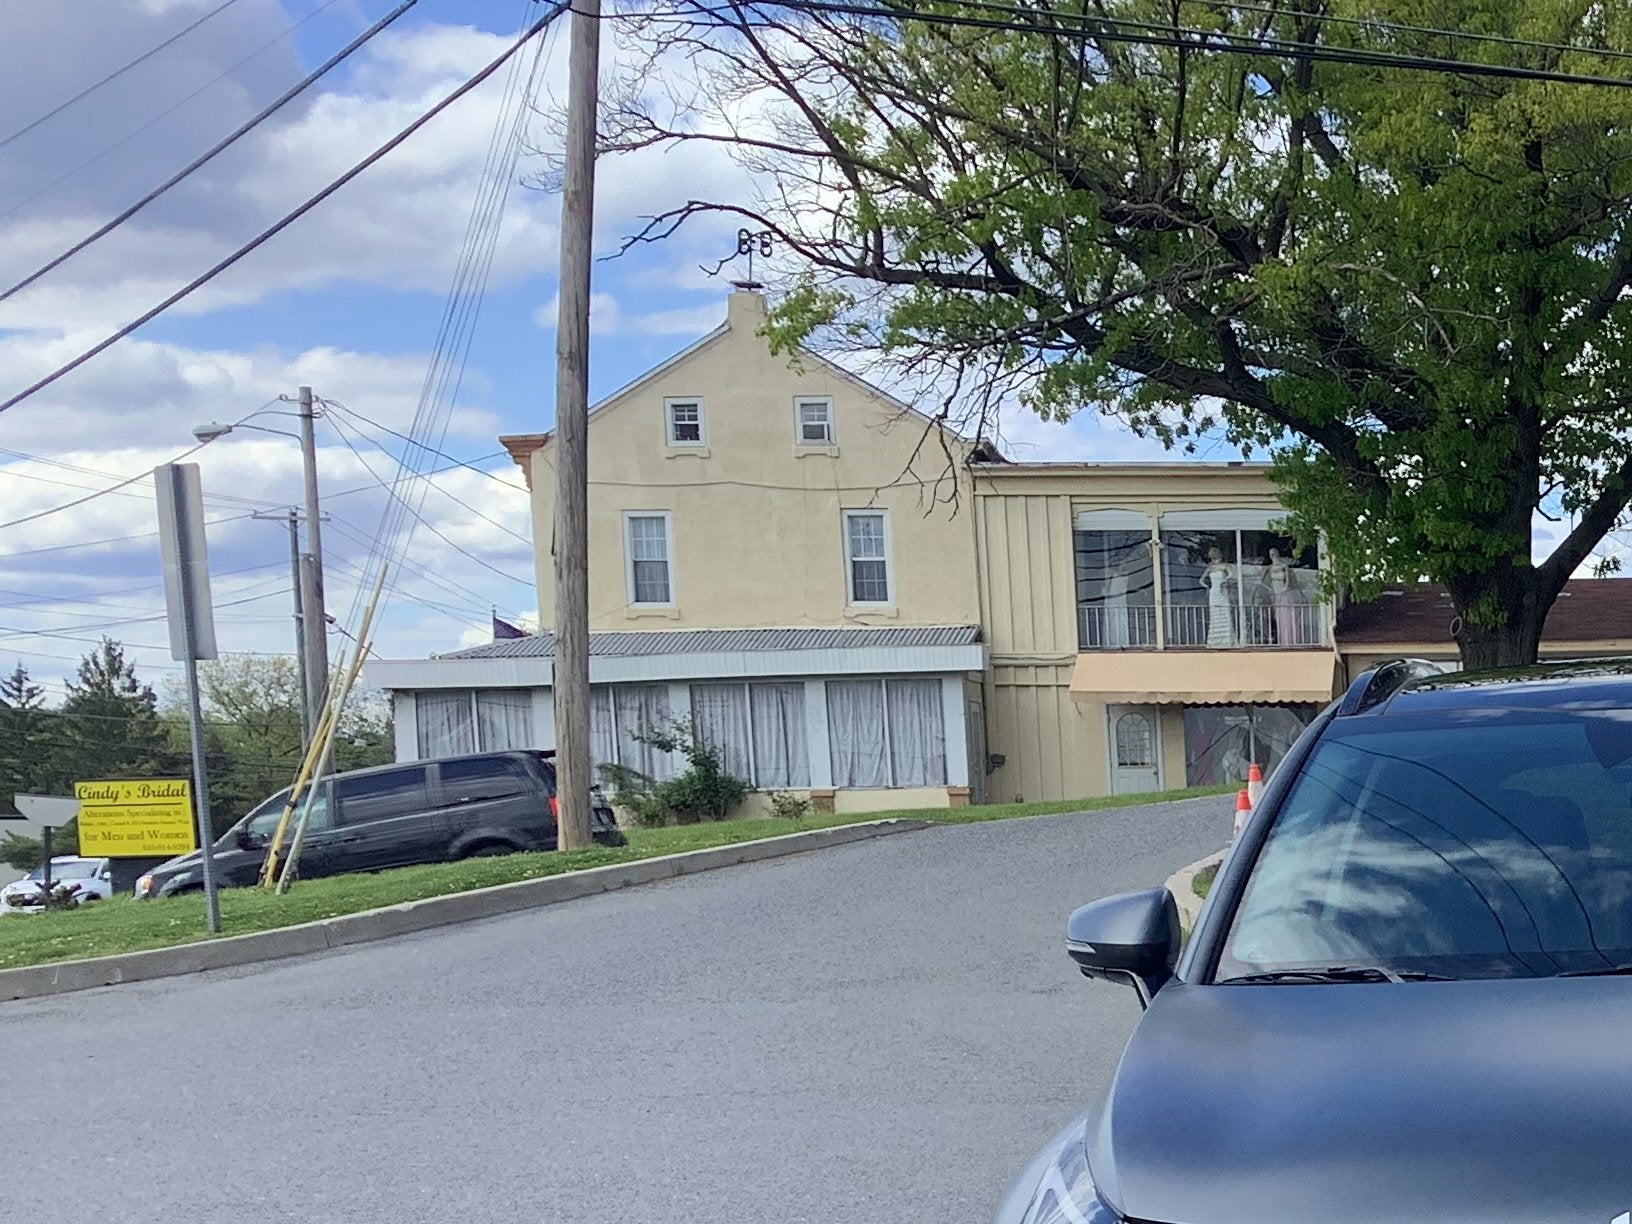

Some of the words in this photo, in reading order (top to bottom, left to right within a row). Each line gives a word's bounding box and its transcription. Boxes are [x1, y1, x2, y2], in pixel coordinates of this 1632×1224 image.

[78, 784, 132, 803] Cindy's
[137, 782, 188, 799] Bridal
[84, 831, 99, 841] for
[101, 830, 125, 841] Men
[127, 829, 145, 840] and
[147, 829, 189, 840] Women
